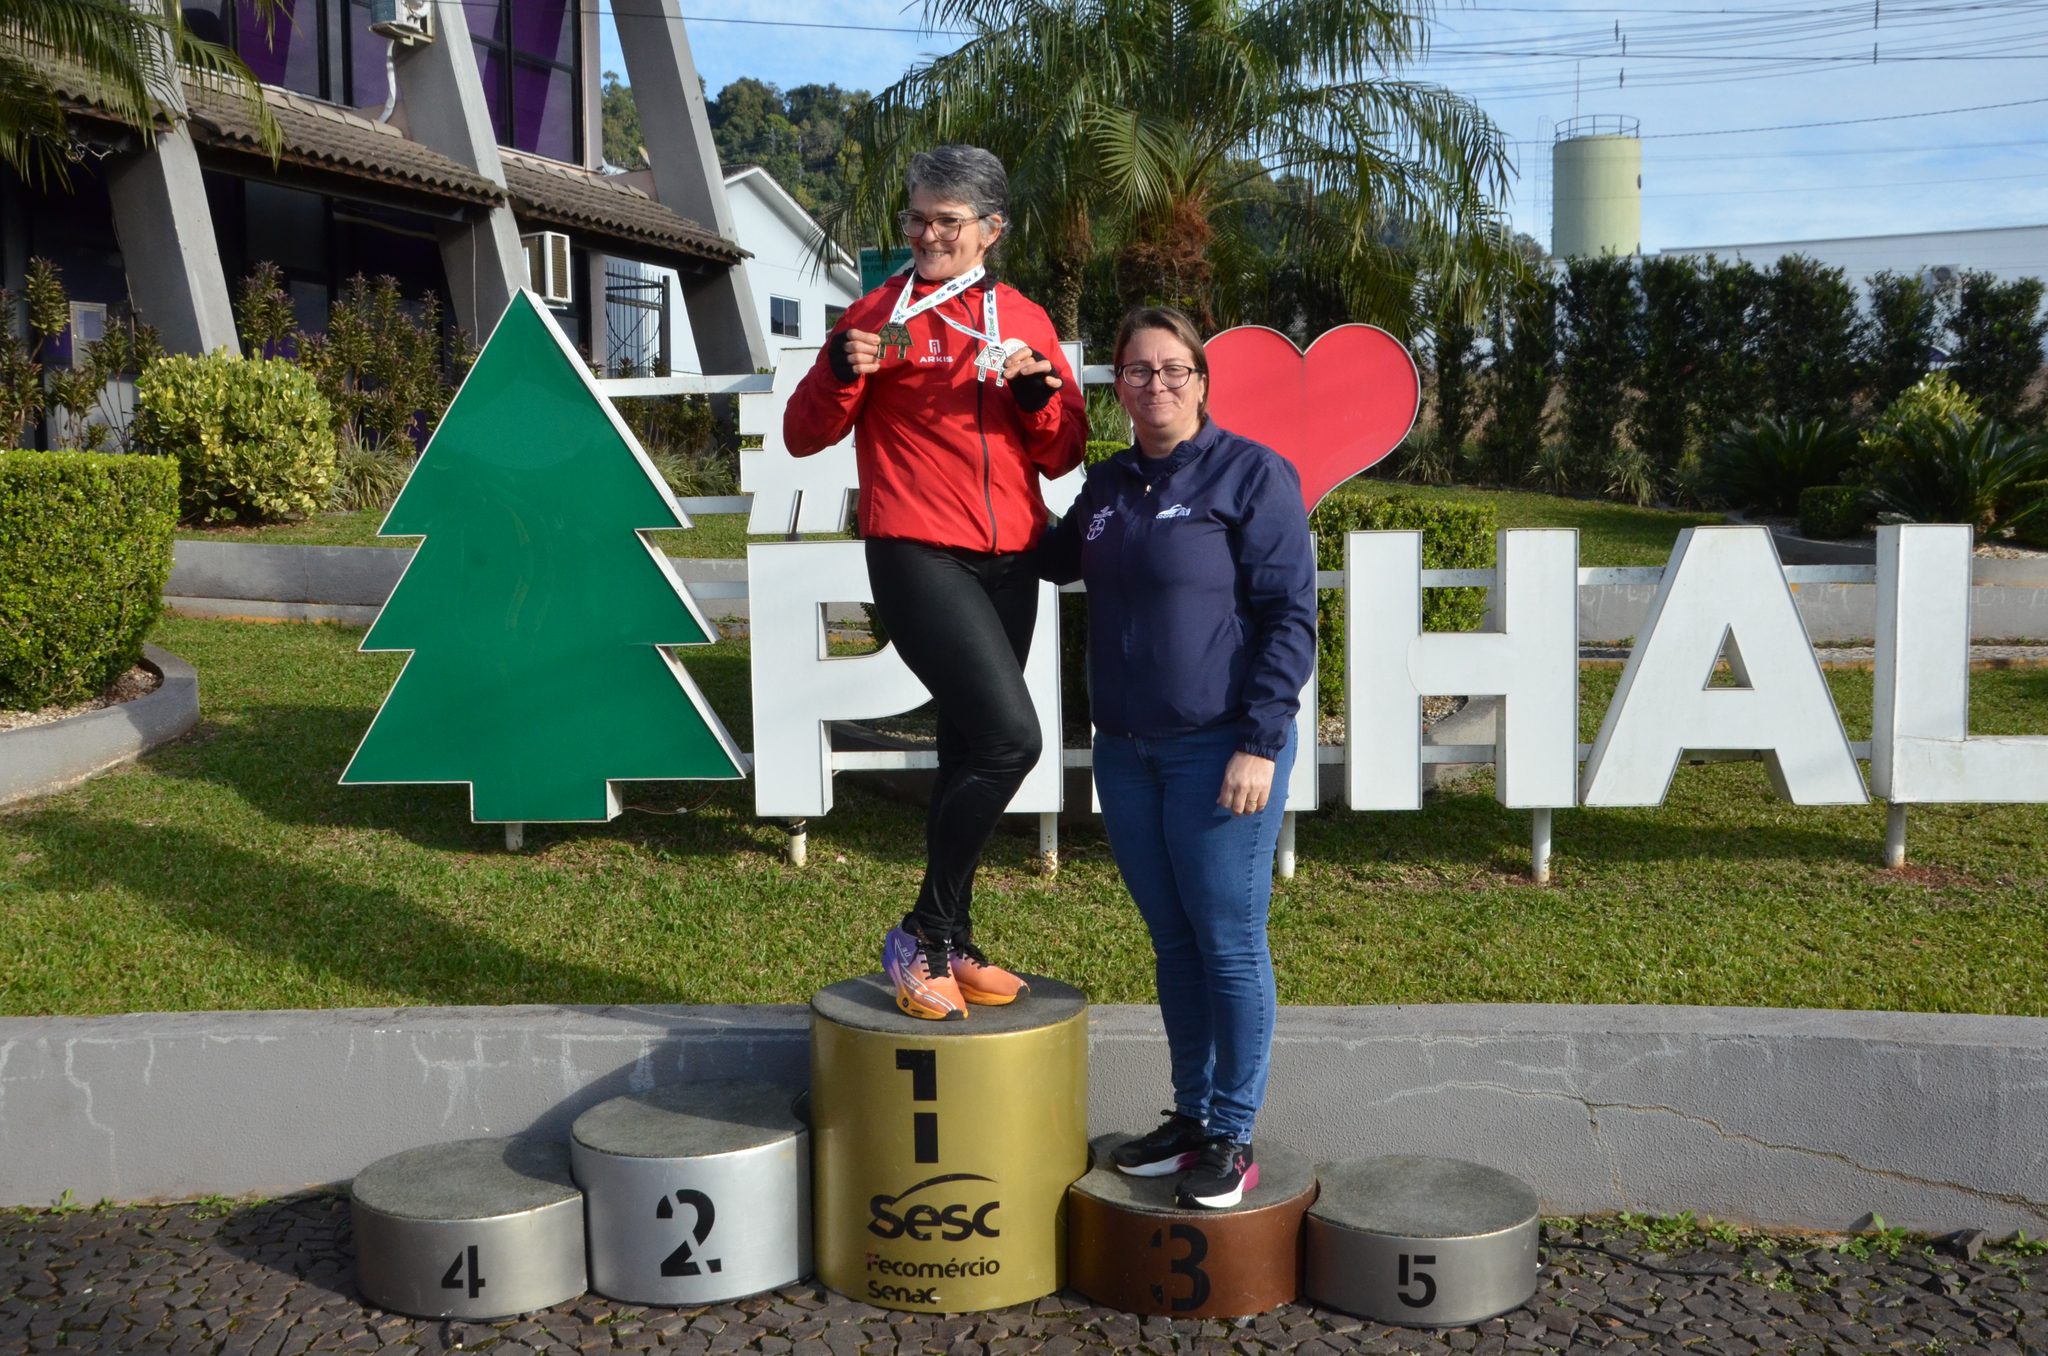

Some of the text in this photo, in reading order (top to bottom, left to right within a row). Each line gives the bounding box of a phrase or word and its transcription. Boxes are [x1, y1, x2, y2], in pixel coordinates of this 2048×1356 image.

[919, 355, 954, 363] ARKIS
[895, 1049, 939, 1164] 1
[656, 1188, 722, 1278] 2
[867, 1188, 1000, 1242] Sesc
[441, 1245, 486, 1299] 4
[868, 1279, 938, 1305] Senac
[1151, 1223, 1211, 1312] 3
[1397, 1254, 1437, 1308] 5
